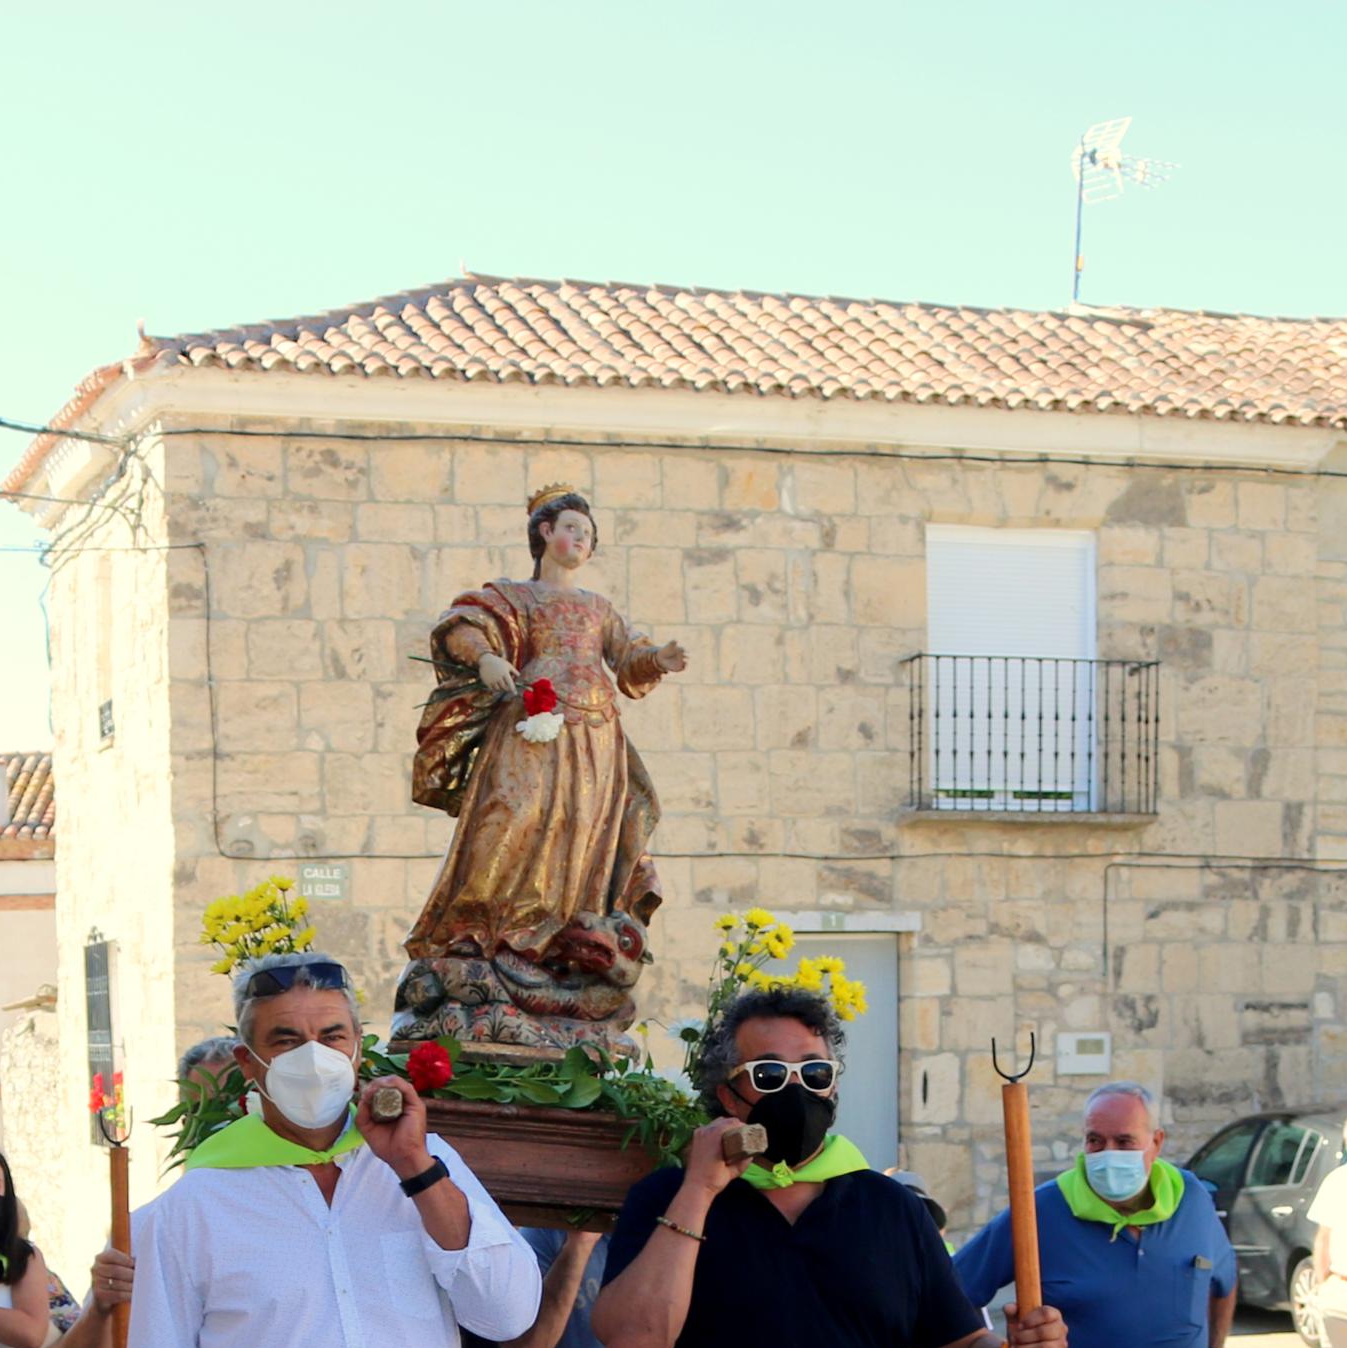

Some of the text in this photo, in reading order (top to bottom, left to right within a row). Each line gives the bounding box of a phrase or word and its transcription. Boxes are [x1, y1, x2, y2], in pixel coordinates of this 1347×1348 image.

[303, 867, 341, 879] CALLE
[302, 884, 313, 896] LA
[830, 914, 836, 927] 1
